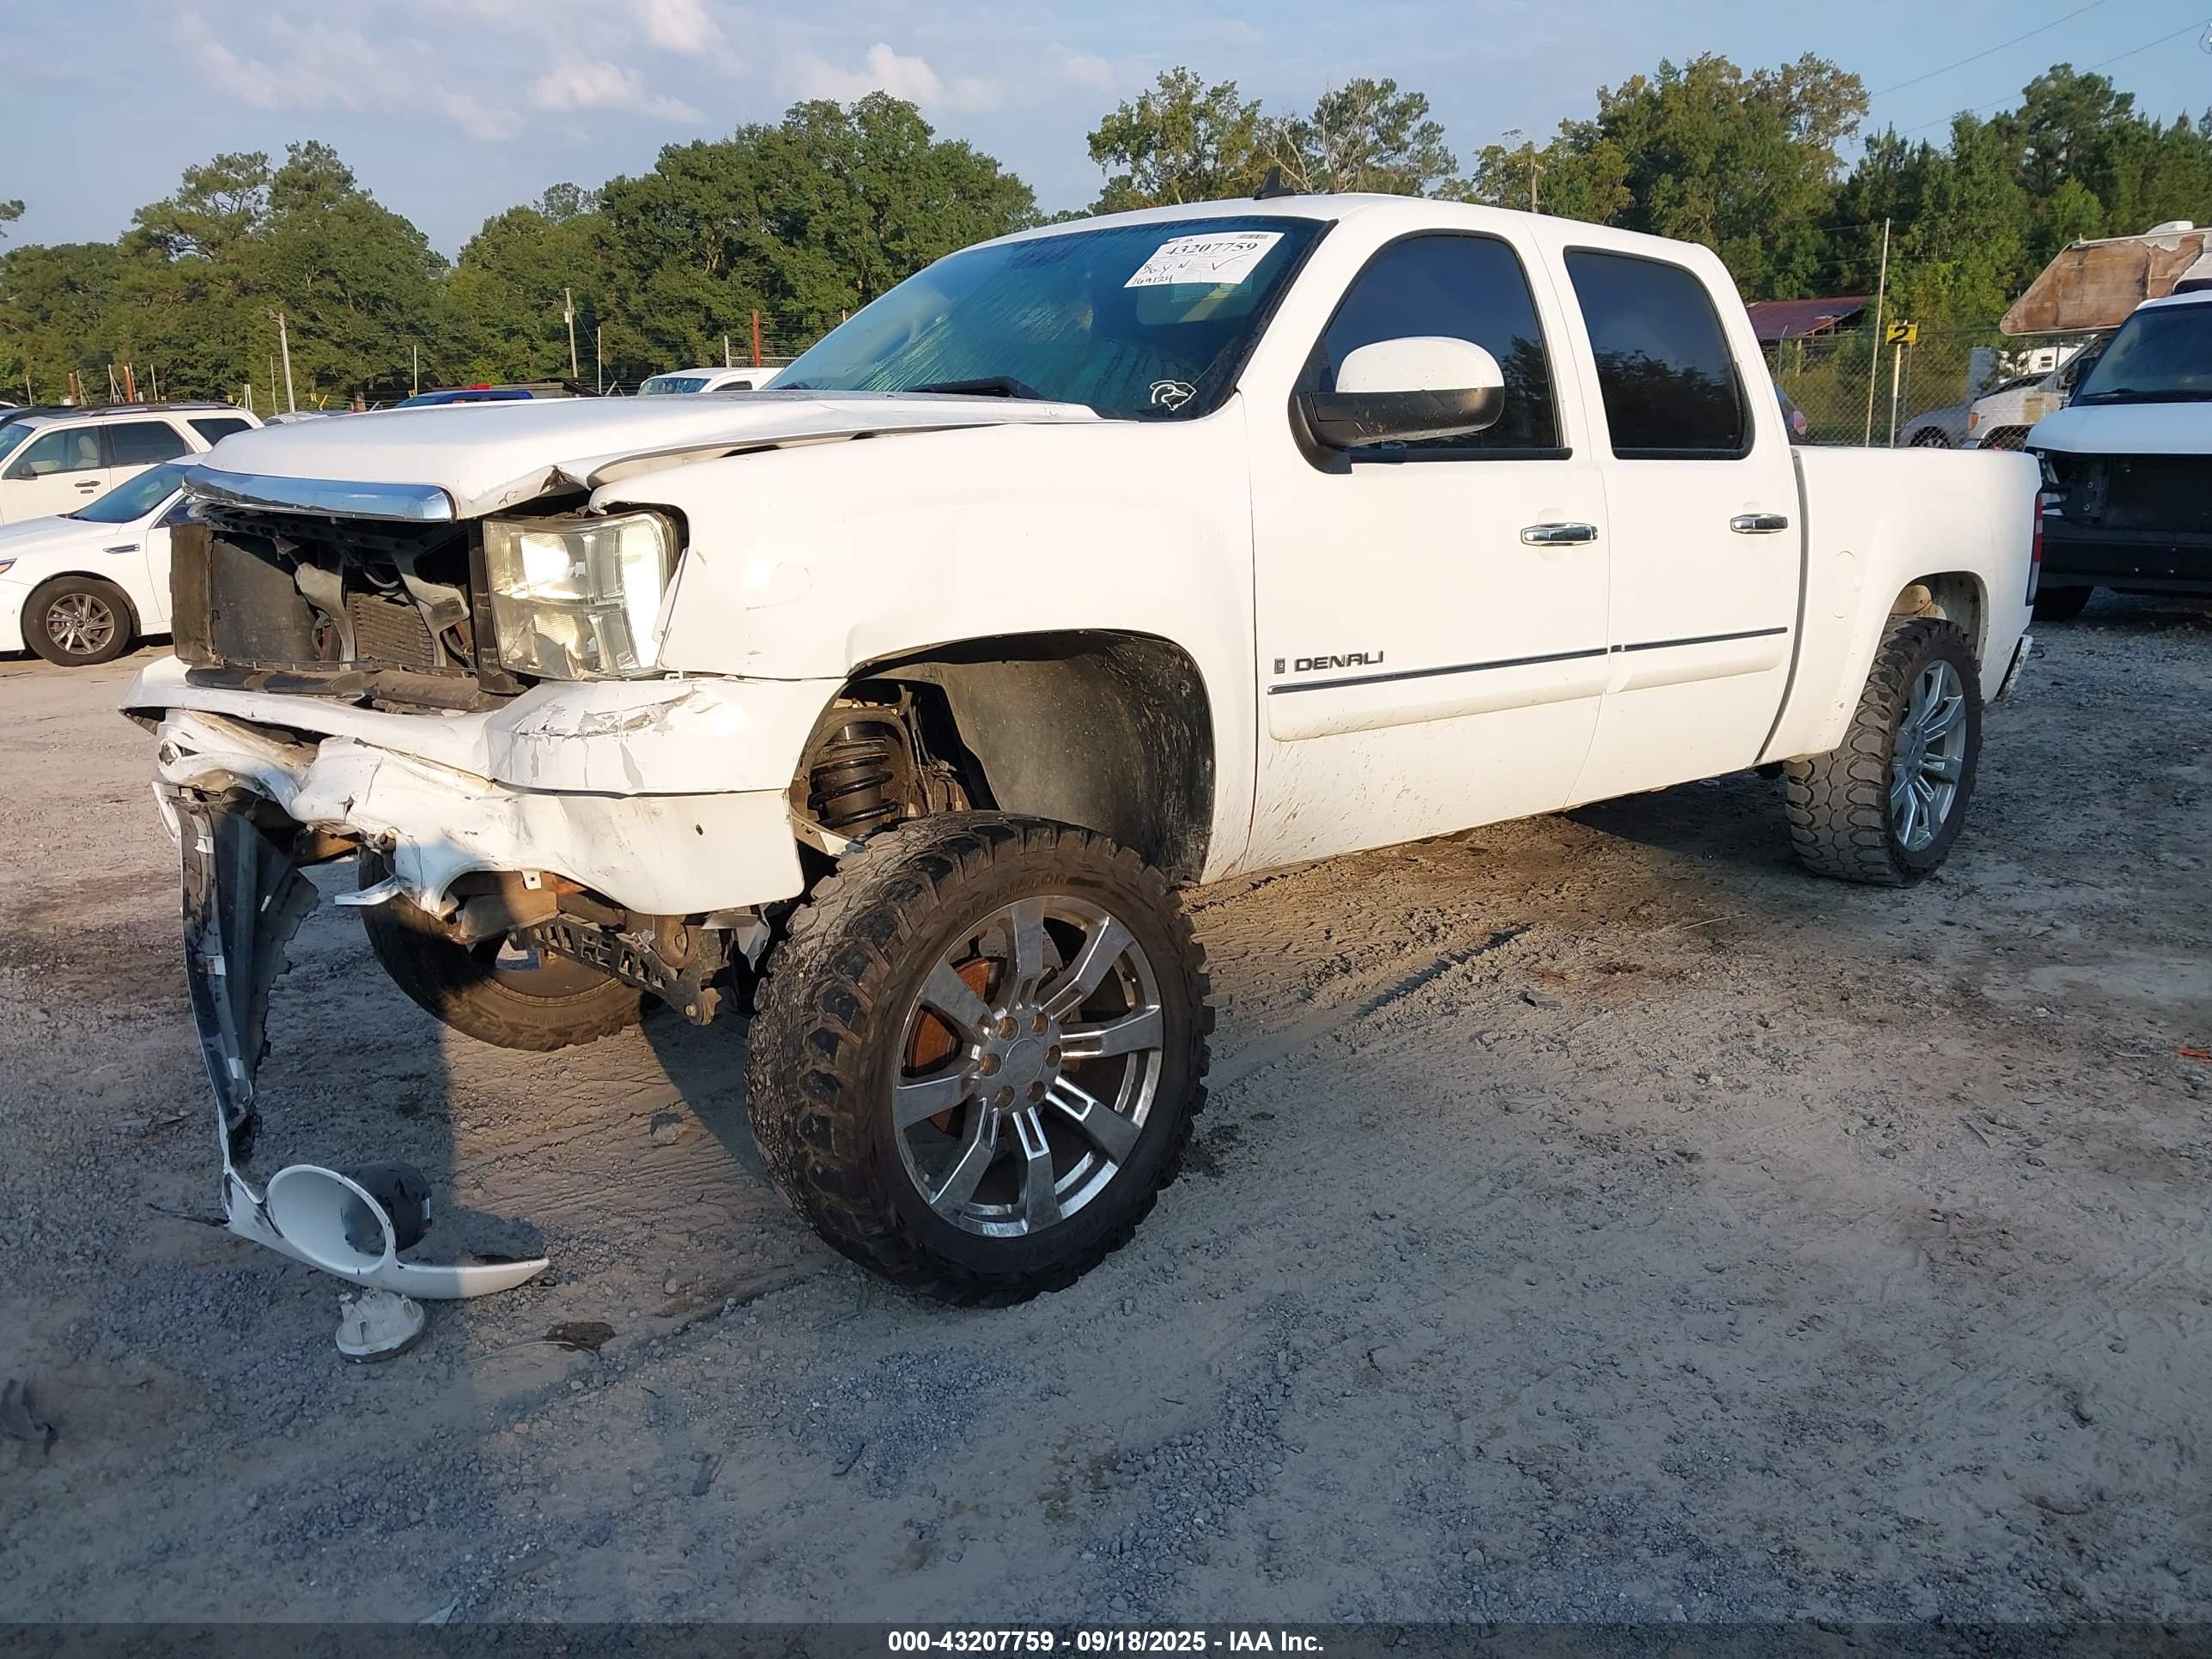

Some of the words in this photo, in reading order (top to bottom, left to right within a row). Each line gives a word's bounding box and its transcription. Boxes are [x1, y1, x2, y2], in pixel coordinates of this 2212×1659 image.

[1166, 242, 1258, 255] 43207759
[1887, 325, 1910, 344] 2
[1294, 650, 1384, 672] DENALI
